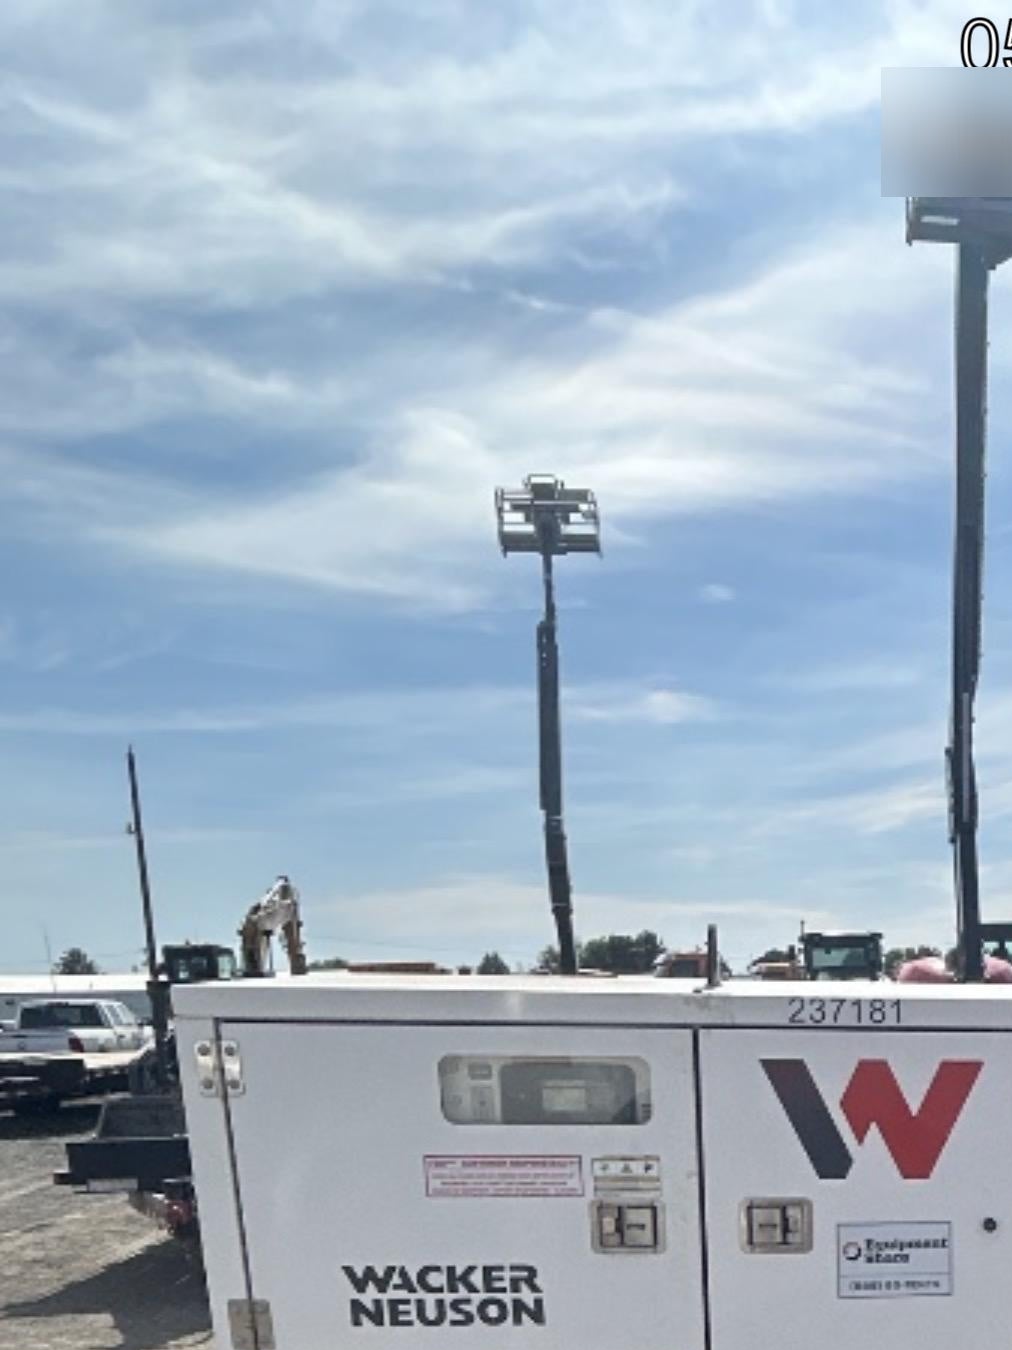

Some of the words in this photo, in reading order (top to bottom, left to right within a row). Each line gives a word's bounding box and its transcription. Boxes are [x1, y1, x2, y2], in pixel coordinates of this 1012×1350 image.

[787, 998, 902, 1024] 237181
[341, 1265, 544, 1294] WACKER
[350, 1298, 546, 1327] NEUSON
